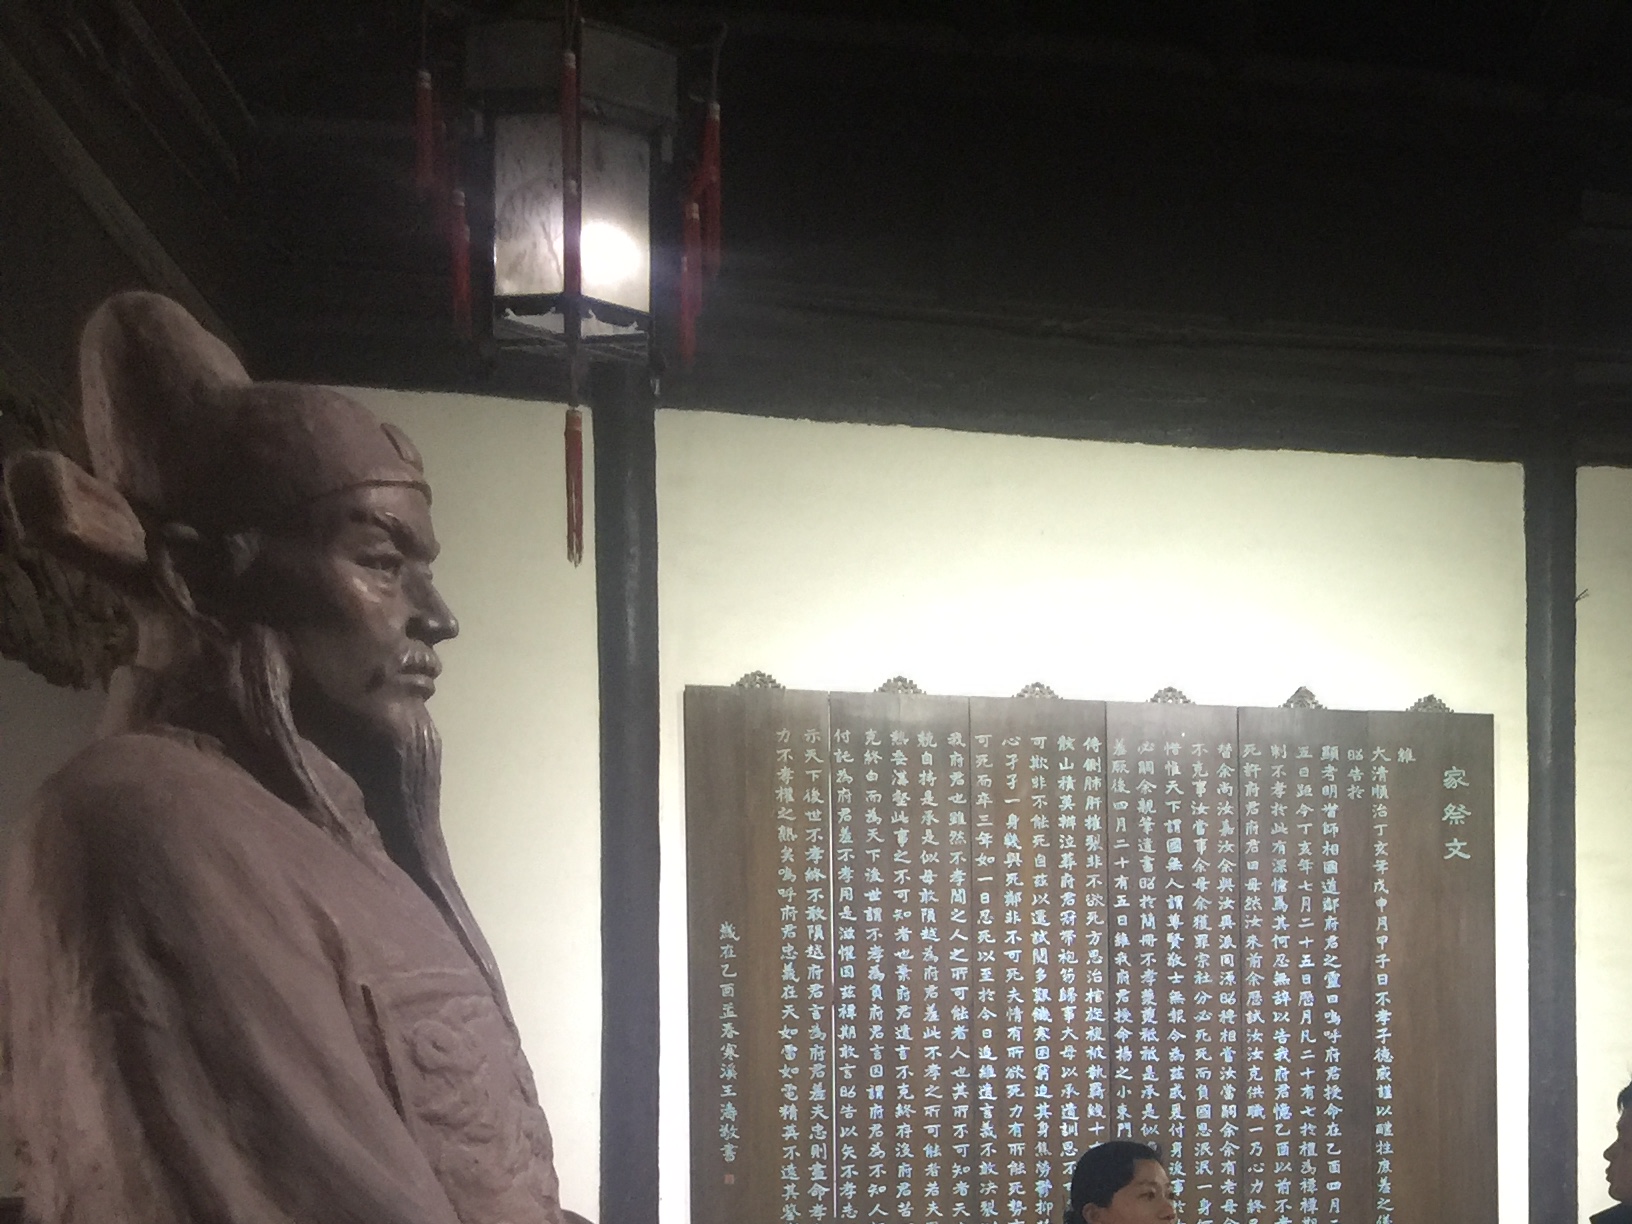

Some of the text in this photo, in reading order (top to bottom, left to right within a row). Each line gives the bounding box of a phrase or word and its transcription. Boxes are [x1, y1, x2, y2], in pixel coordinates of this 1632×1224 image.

[1347, 749, 1364, 799] 昭告於
[1398, 748, 1416, 763] 維
[1442, 766, 1471, 859] 家祭文
